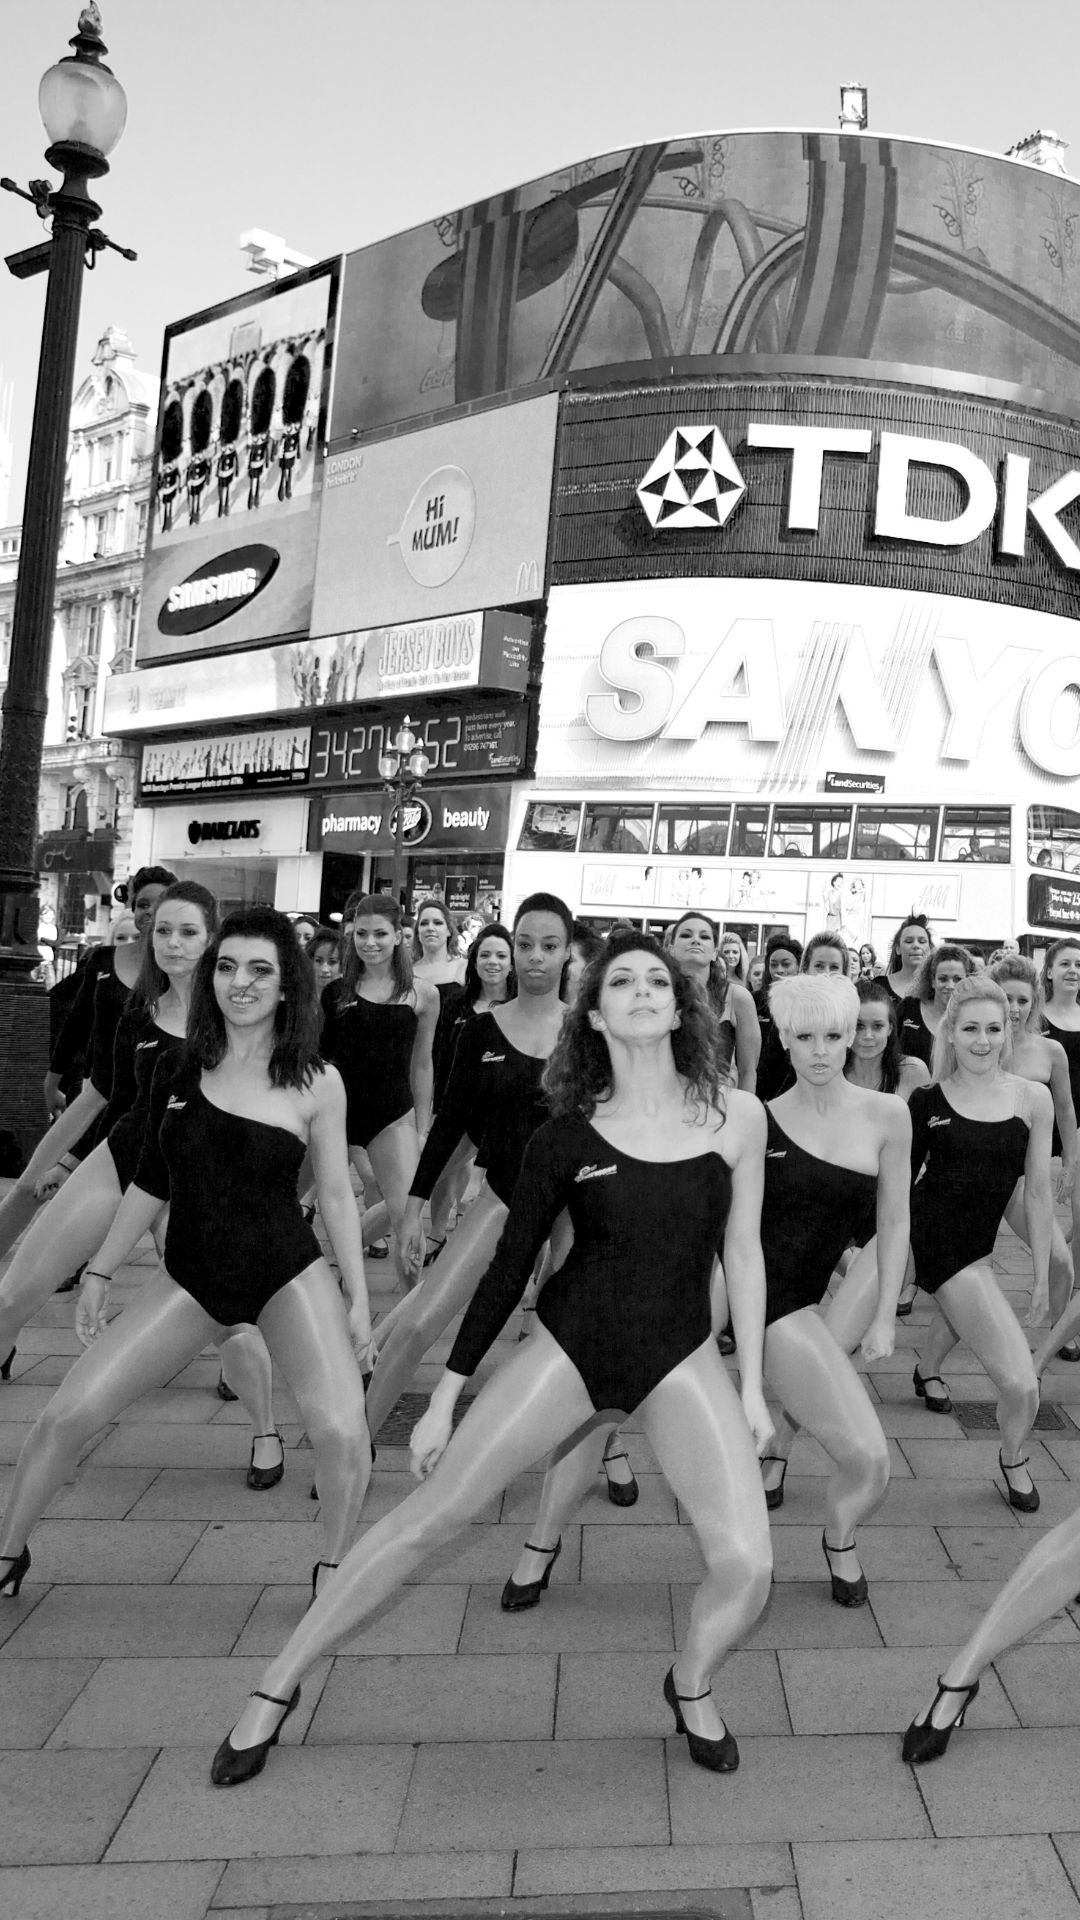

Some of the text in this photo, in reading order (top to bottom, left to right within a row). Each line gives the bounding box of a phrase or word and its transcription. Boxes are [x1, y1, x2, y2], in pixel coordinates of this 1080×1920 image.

[327, 455, 364, 476] LONDON
[426, 494, 445, 522] Hi
[747, 423, 1080, 571] TDK
[412, 517, 460, 551] MUM!
[167, 567, 257, 612] SAMSUNG
[378, 618, 476, 677] JERSEY BOYS
[831, 778, 880, 790] LandSecurities
[201, 819, 261, 840] BARCLAYS
[321, 813, 382, 836] pharmacy
[443, 806, 490, 831] beauty
